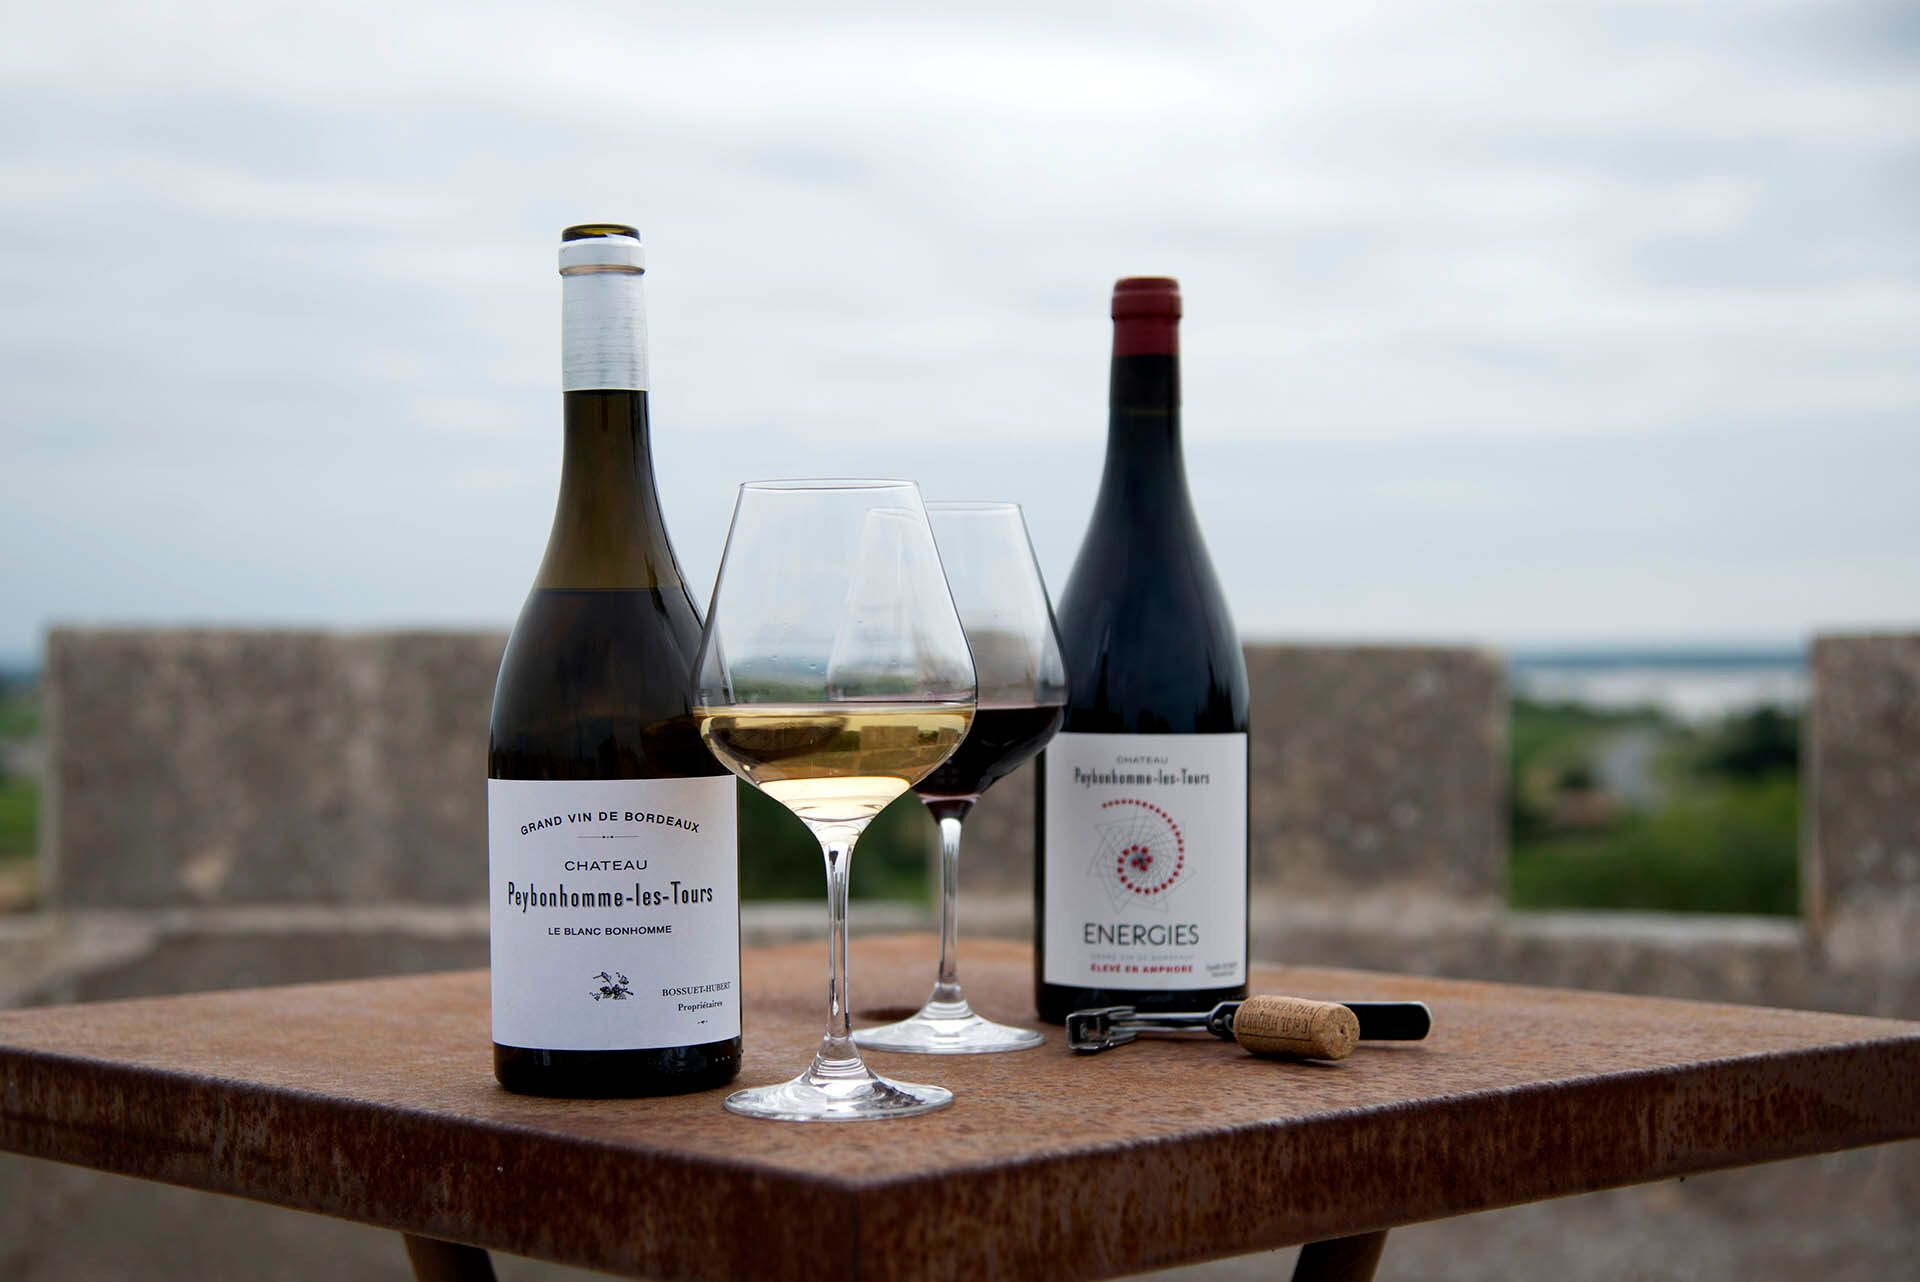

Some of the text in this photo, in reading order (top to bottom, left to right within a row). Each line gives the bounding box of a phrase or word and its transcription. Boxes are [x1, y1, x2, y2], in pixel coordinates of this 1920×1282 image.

[1116, 755, 1169, 765] CHATEAU
[1074, 766, 1211, 789] Peybonhomme-les-Tours
[520, 811, 700, 835] GRAND VIN DE BORDEAUX
[564, 859, 648, 872] CHATEAU
[507, 880, 714, 913] Peybonhomme-les-Tours
[548, 925, 673, 937] LE BLANC BONHOMME
[1083, 922, 1200, 946] ENERGIES
[1125, 964, 1139, 974] EN
[1142, 964, 1194, 975] AMPHORE
[661, 981, 732, 997] BOSSUET-HUBERT
[677, 999, 724, 1013] Propriétaires
